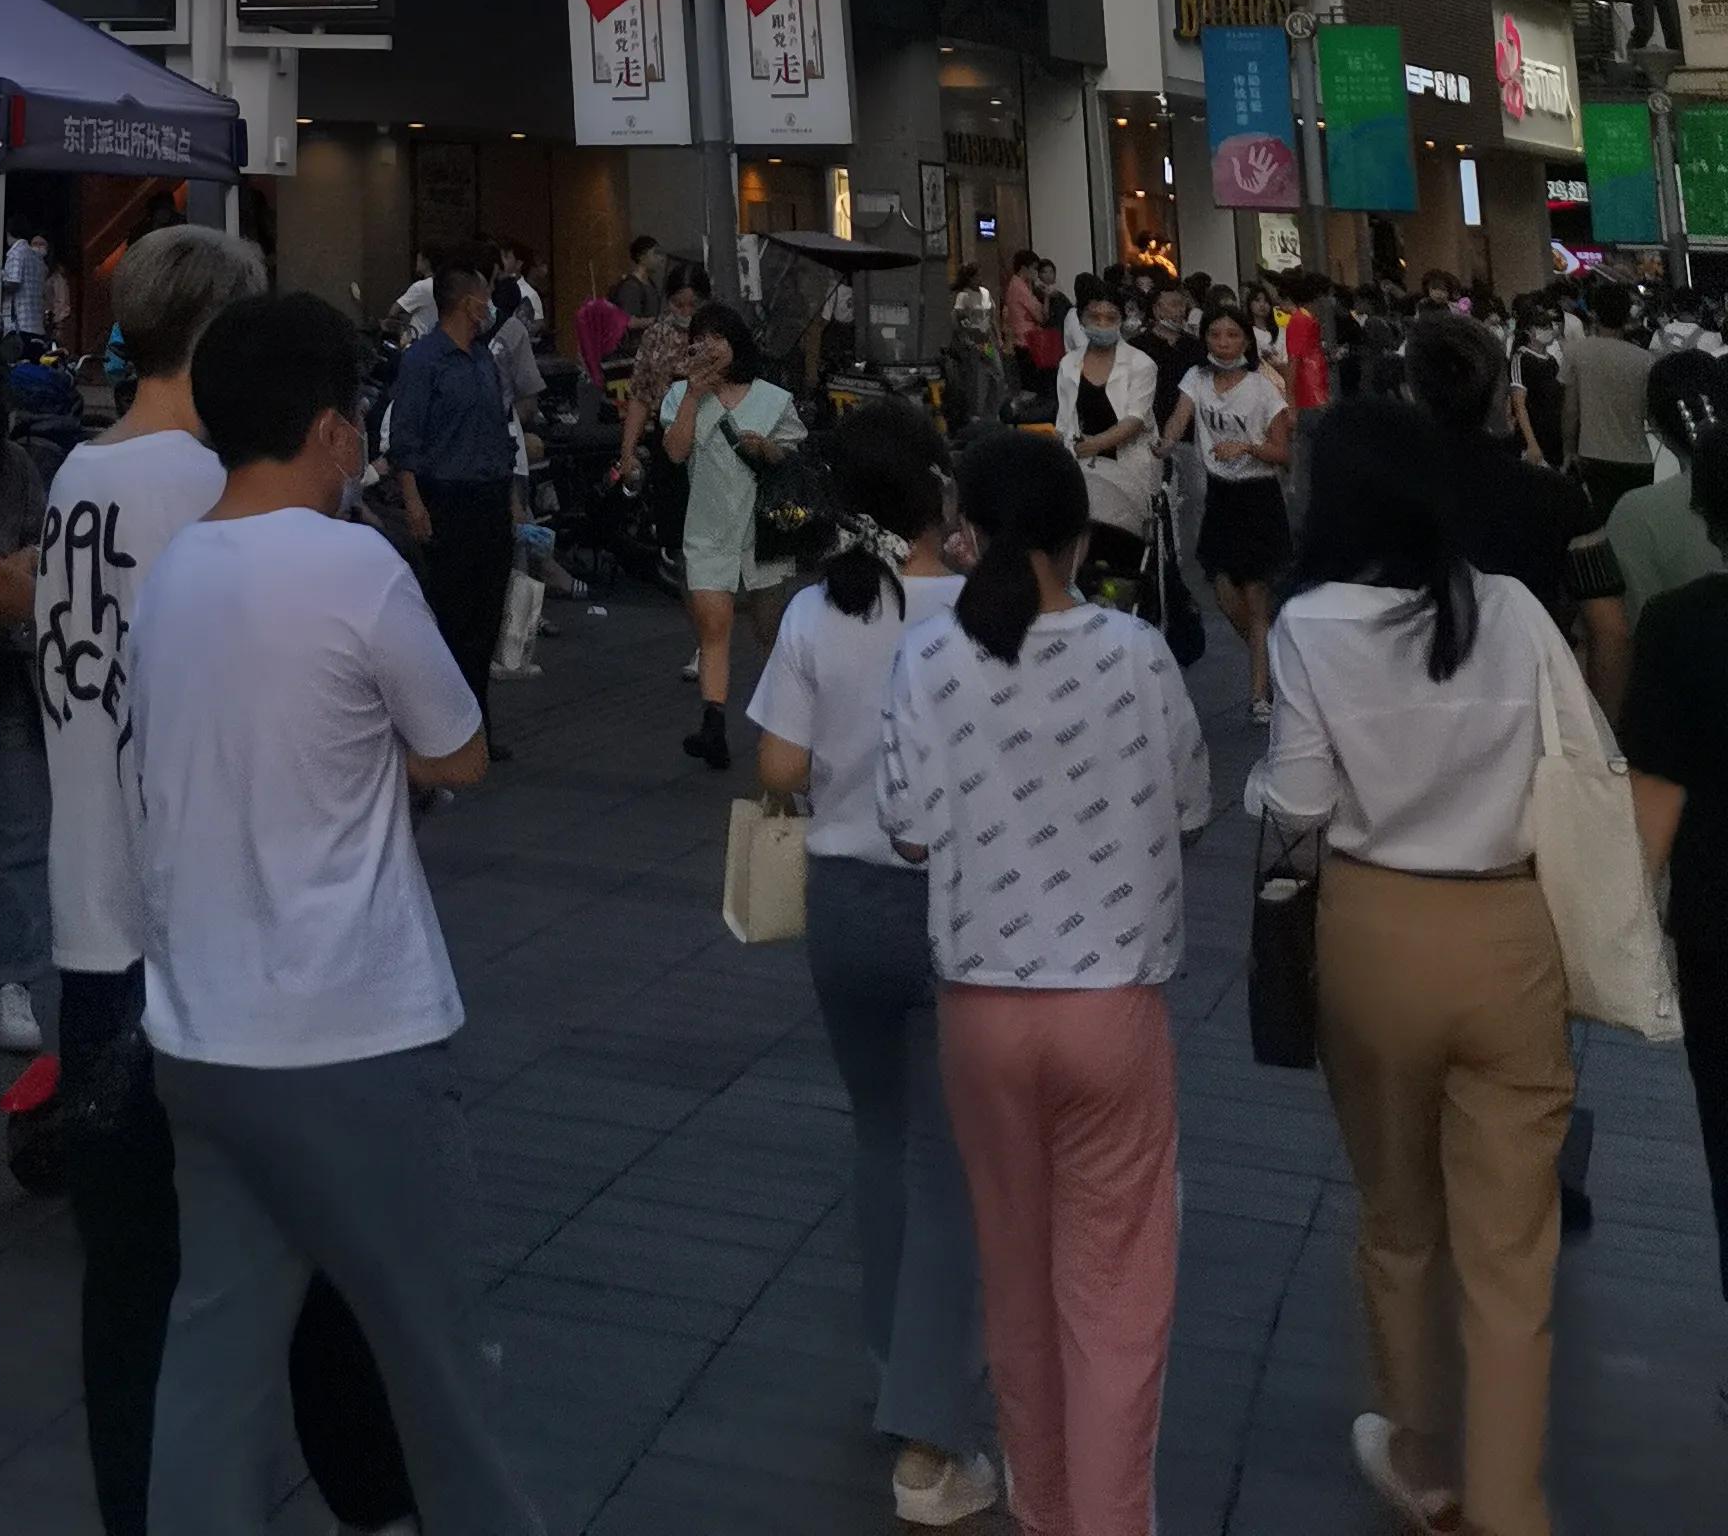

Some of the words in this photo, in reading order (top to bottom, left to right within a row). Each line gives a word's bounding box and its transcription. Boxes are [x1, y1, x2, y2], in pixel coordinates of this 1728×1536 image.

[612, 19, 643, 88] 跟党走
[771, 14, 801, 85] 跟党走
[62, 114, 193, 165] 东门派出所执勤点
